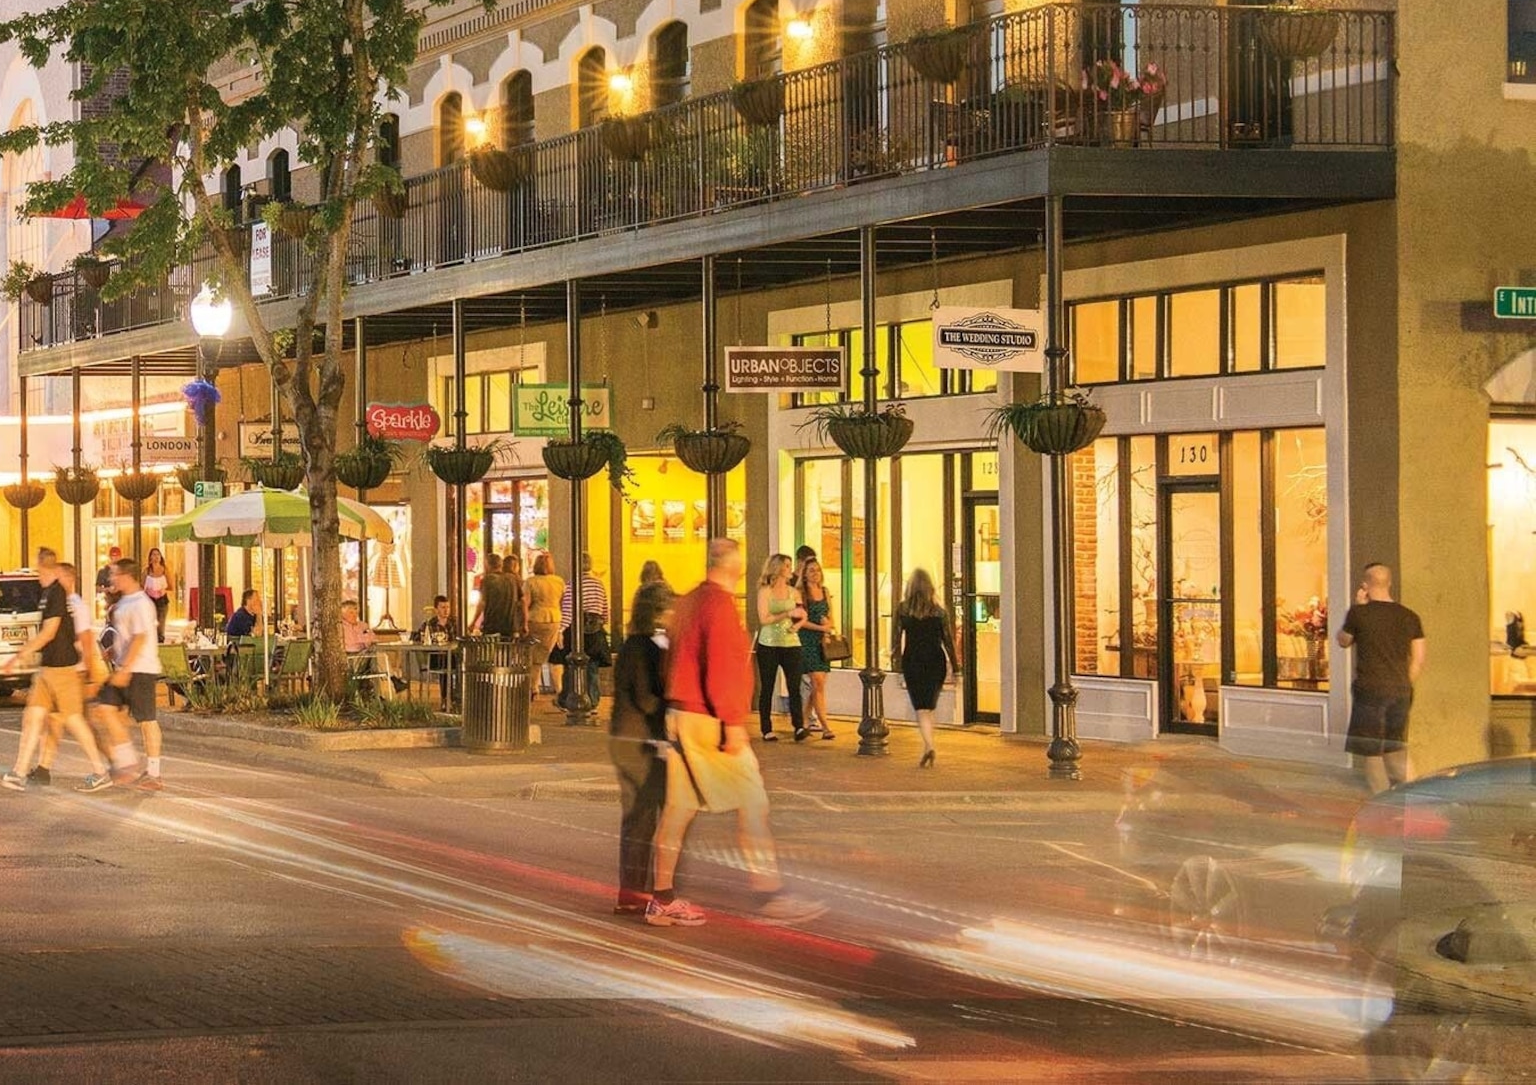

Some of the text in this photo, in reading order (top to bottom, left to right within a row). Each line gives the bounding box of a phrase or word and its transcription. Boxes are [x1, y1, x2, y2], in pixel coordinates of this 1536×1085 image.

[255, 227, 267, 242] FOR
[1499, 291, 1536, 314] E INT
[944, 331, 1032, 346] THE WEDDING STUDIO
[731, 375, 759, 384] Lighting
[763, 376, 780, 384] Style
[371, 408, 431, 431] Sparkle
[146, 441, 191, 451] LONDON
[1180, 445, 1207, 464] 130
[196, 484, 203, 496] 2
